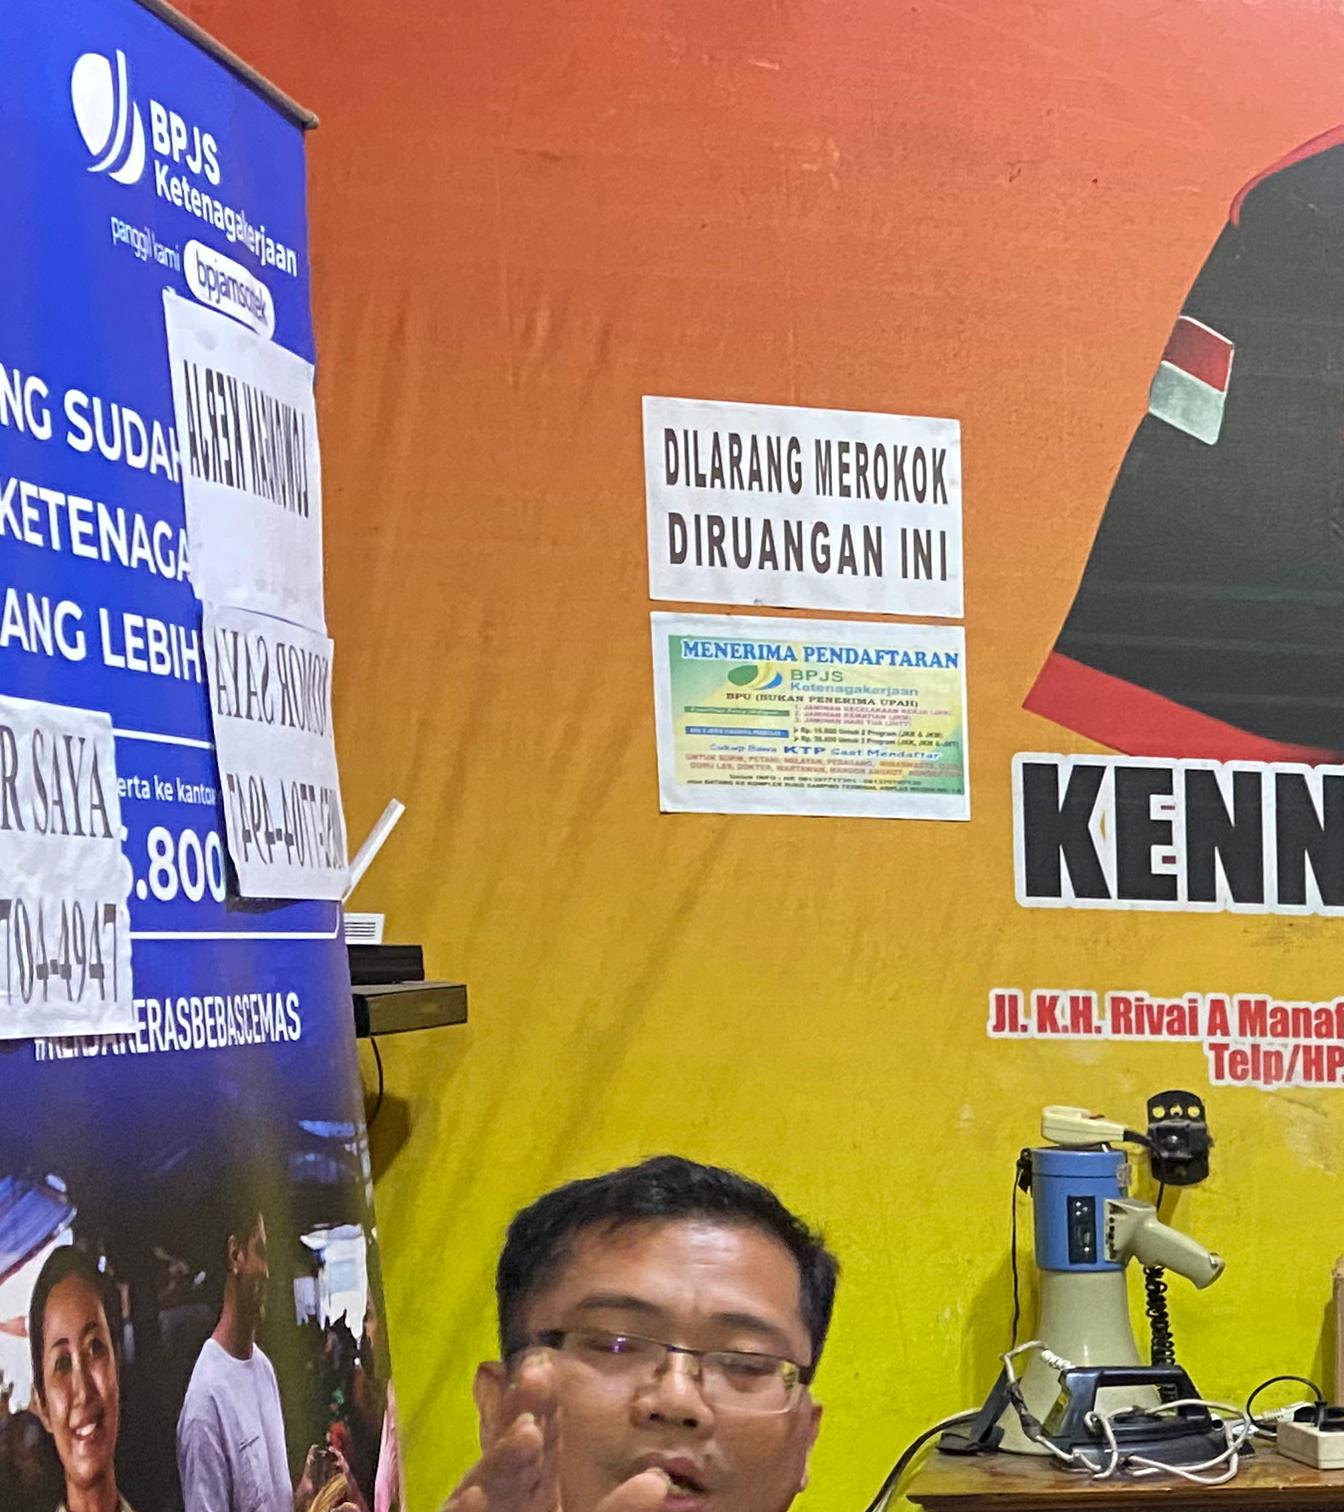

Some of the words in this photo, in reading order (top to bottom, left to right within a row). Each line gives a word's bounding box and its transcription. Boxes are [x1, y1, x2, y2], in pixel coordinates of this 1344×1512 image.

[150, 100, 221, 186] BPJS
[153, 158, 299, 278] Ketenagakerjaan
[0, 362, 51, 441] NG
[663, 427, 802, 495] DILARANG
[814, 438, 949, 506] MEROKOK
[667, 511, 884, 578] DIRUANGAN
[900, 526, 948, 582] INI
[0, 587, 87, 663] ANG
[99, 607, 202, 684] LEBIH
[683, 640, 798, 662] MENERIMA
[802, 646, 959, 669] PENDAFTARAN
[790, 669, 844, 683] BPJS
[790, 682, 919, 697] Ketenagakerjaan
[32, 728, 115, 839] SAYA
[783, 746, 827, 755] KTP
[153, 774, 174, 802] ke
[1036, 995, 1102, 1036] K.H.
[1110, 996, 1200, 1037] Rivai
[1206, 999, 1231, 1039] A
